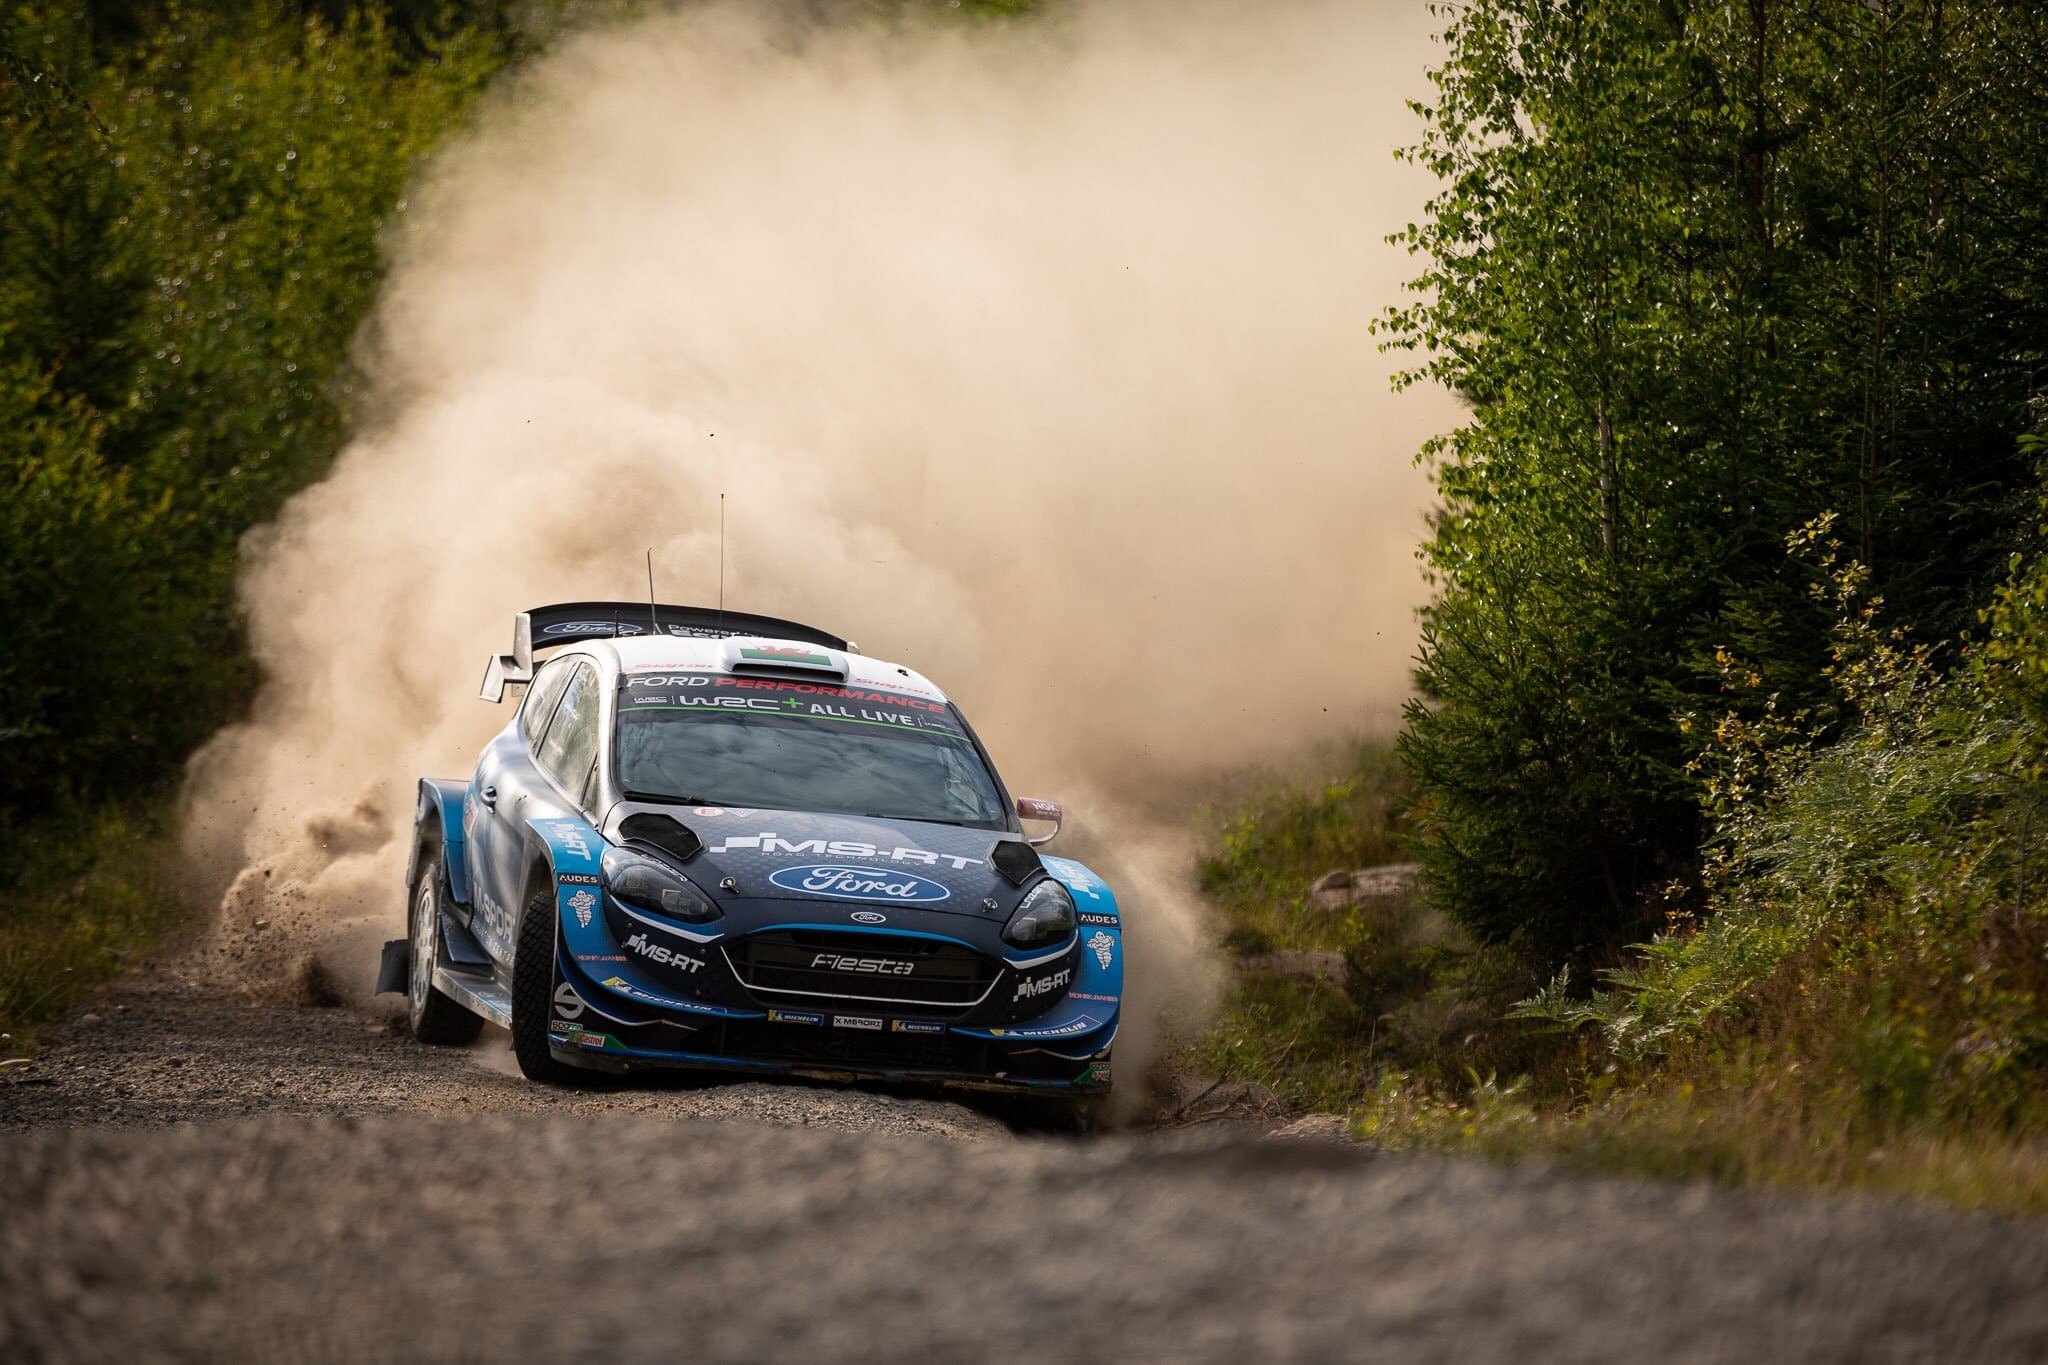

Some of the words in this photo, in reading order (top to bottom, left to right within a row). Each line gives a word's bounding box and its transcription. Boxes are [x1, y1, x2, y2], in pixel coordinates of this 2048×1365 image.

[626, 676, 710, 688] FORD
[714, 678, 945, 714] PERFORMANCE
[809, 702, 855, 718] ALL
[861, 708, 915, 726] LIVE
[559, 874, 598, 883] AUDES
[801, 866, 919, 898] Ford
[473, 881, 517, 945] M-SPOR
[1081, 913, 1118, 924] AUDES
[810, 953, 915, 975] Fiesta
[783, 1014, 820, 1023] MICHELIN
[1023, 1021, 1087, 1036] MICHELIN
